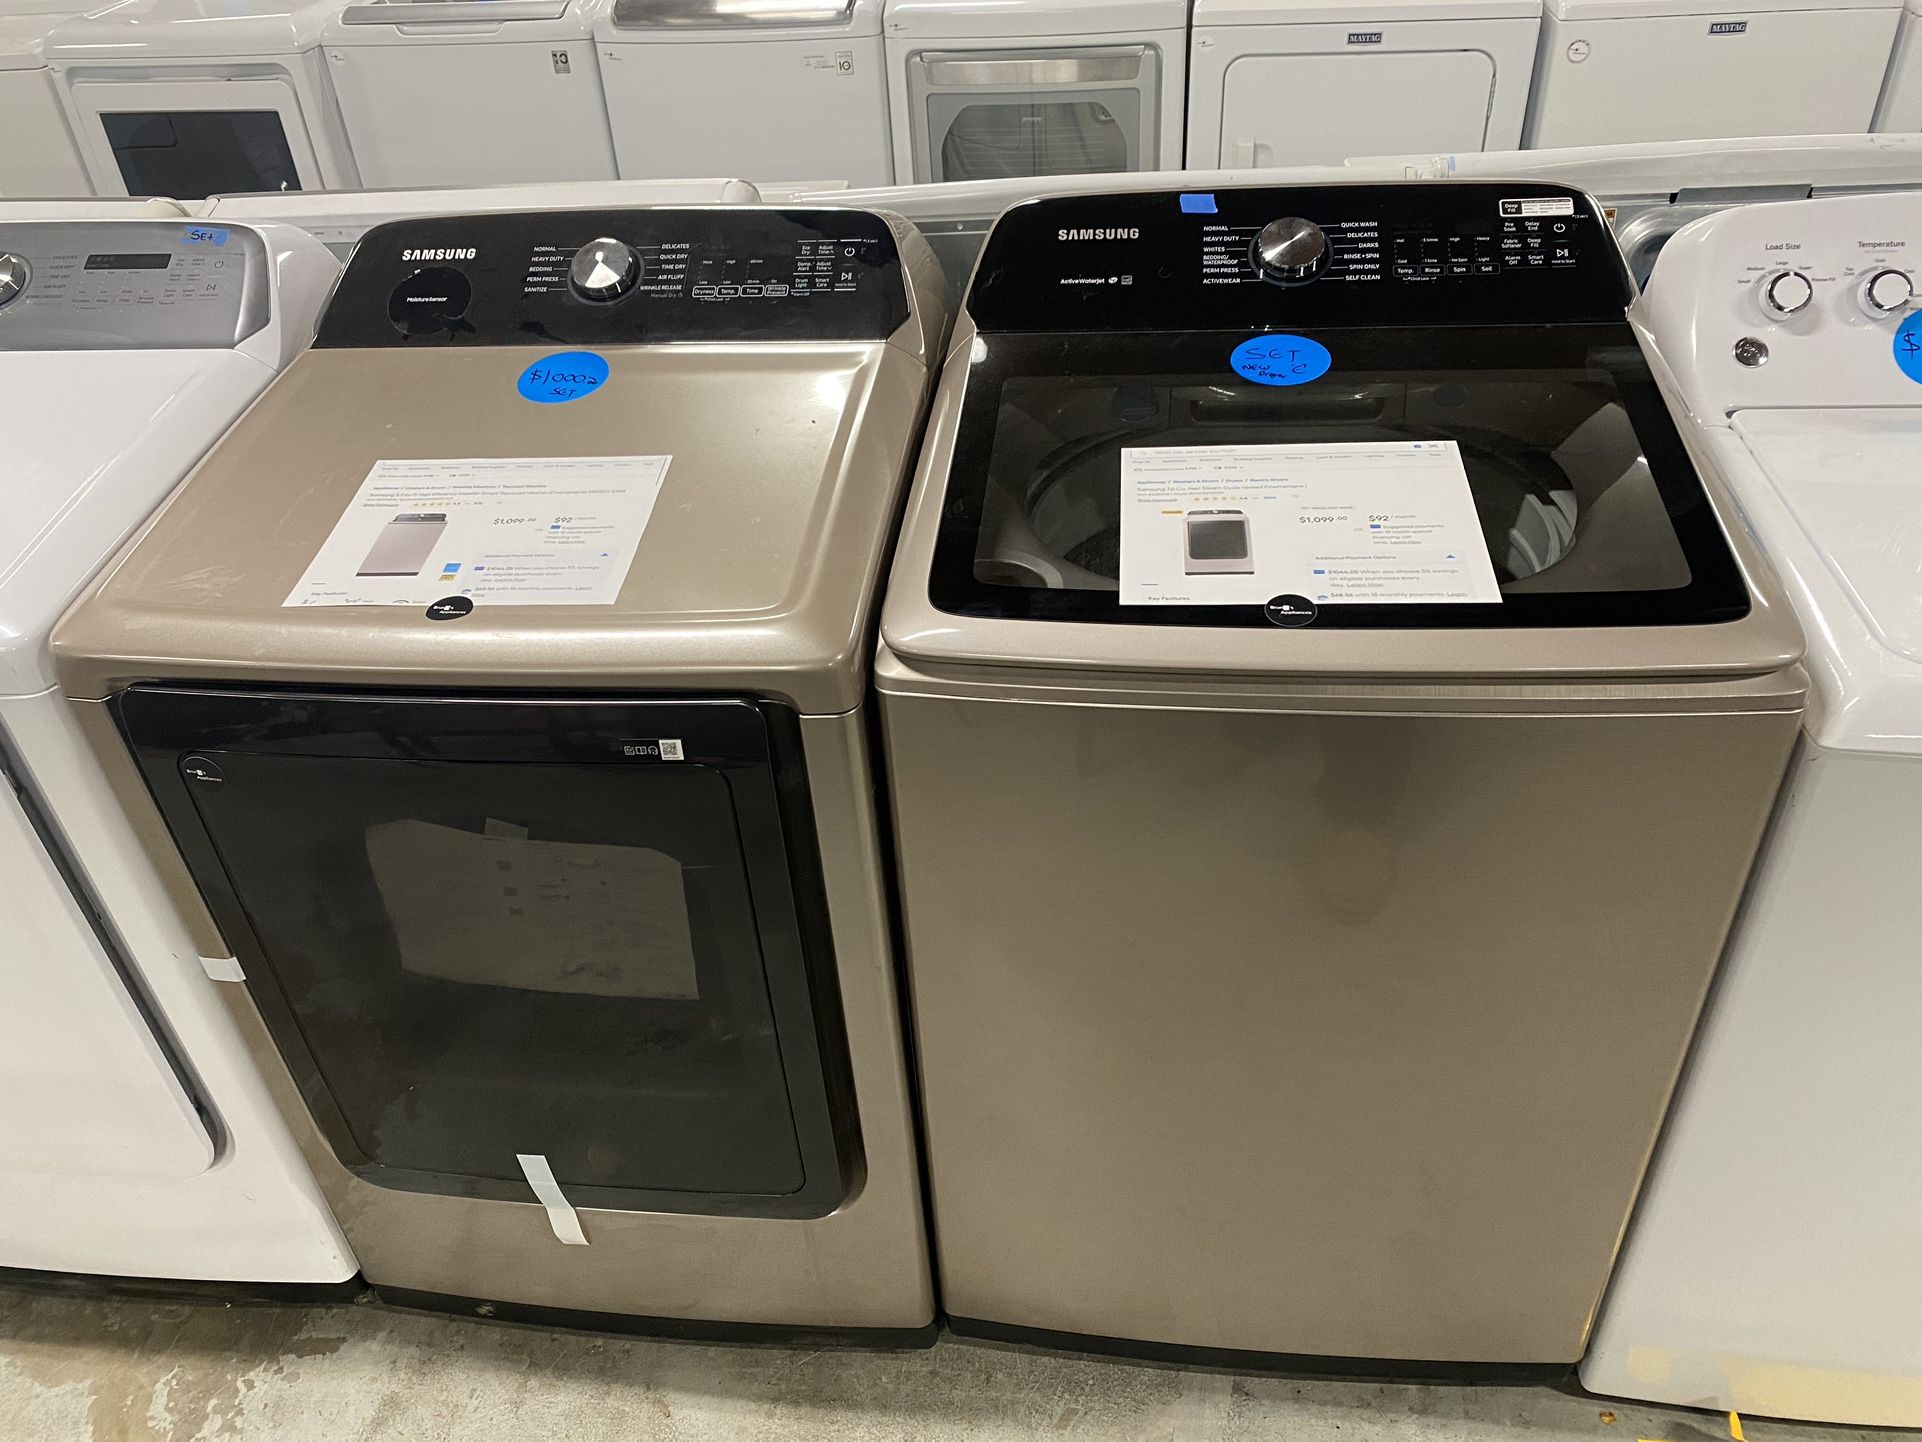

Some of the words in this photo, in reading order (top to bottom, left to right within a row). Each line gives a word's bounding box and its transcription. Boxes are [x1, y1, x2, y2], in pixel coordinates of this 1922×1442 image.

[1058, 228, 1139, 241] SAMSUNG
[402, 248, 476, 261] SAMSUNG
[1245, 347, 1300, 362] SET
